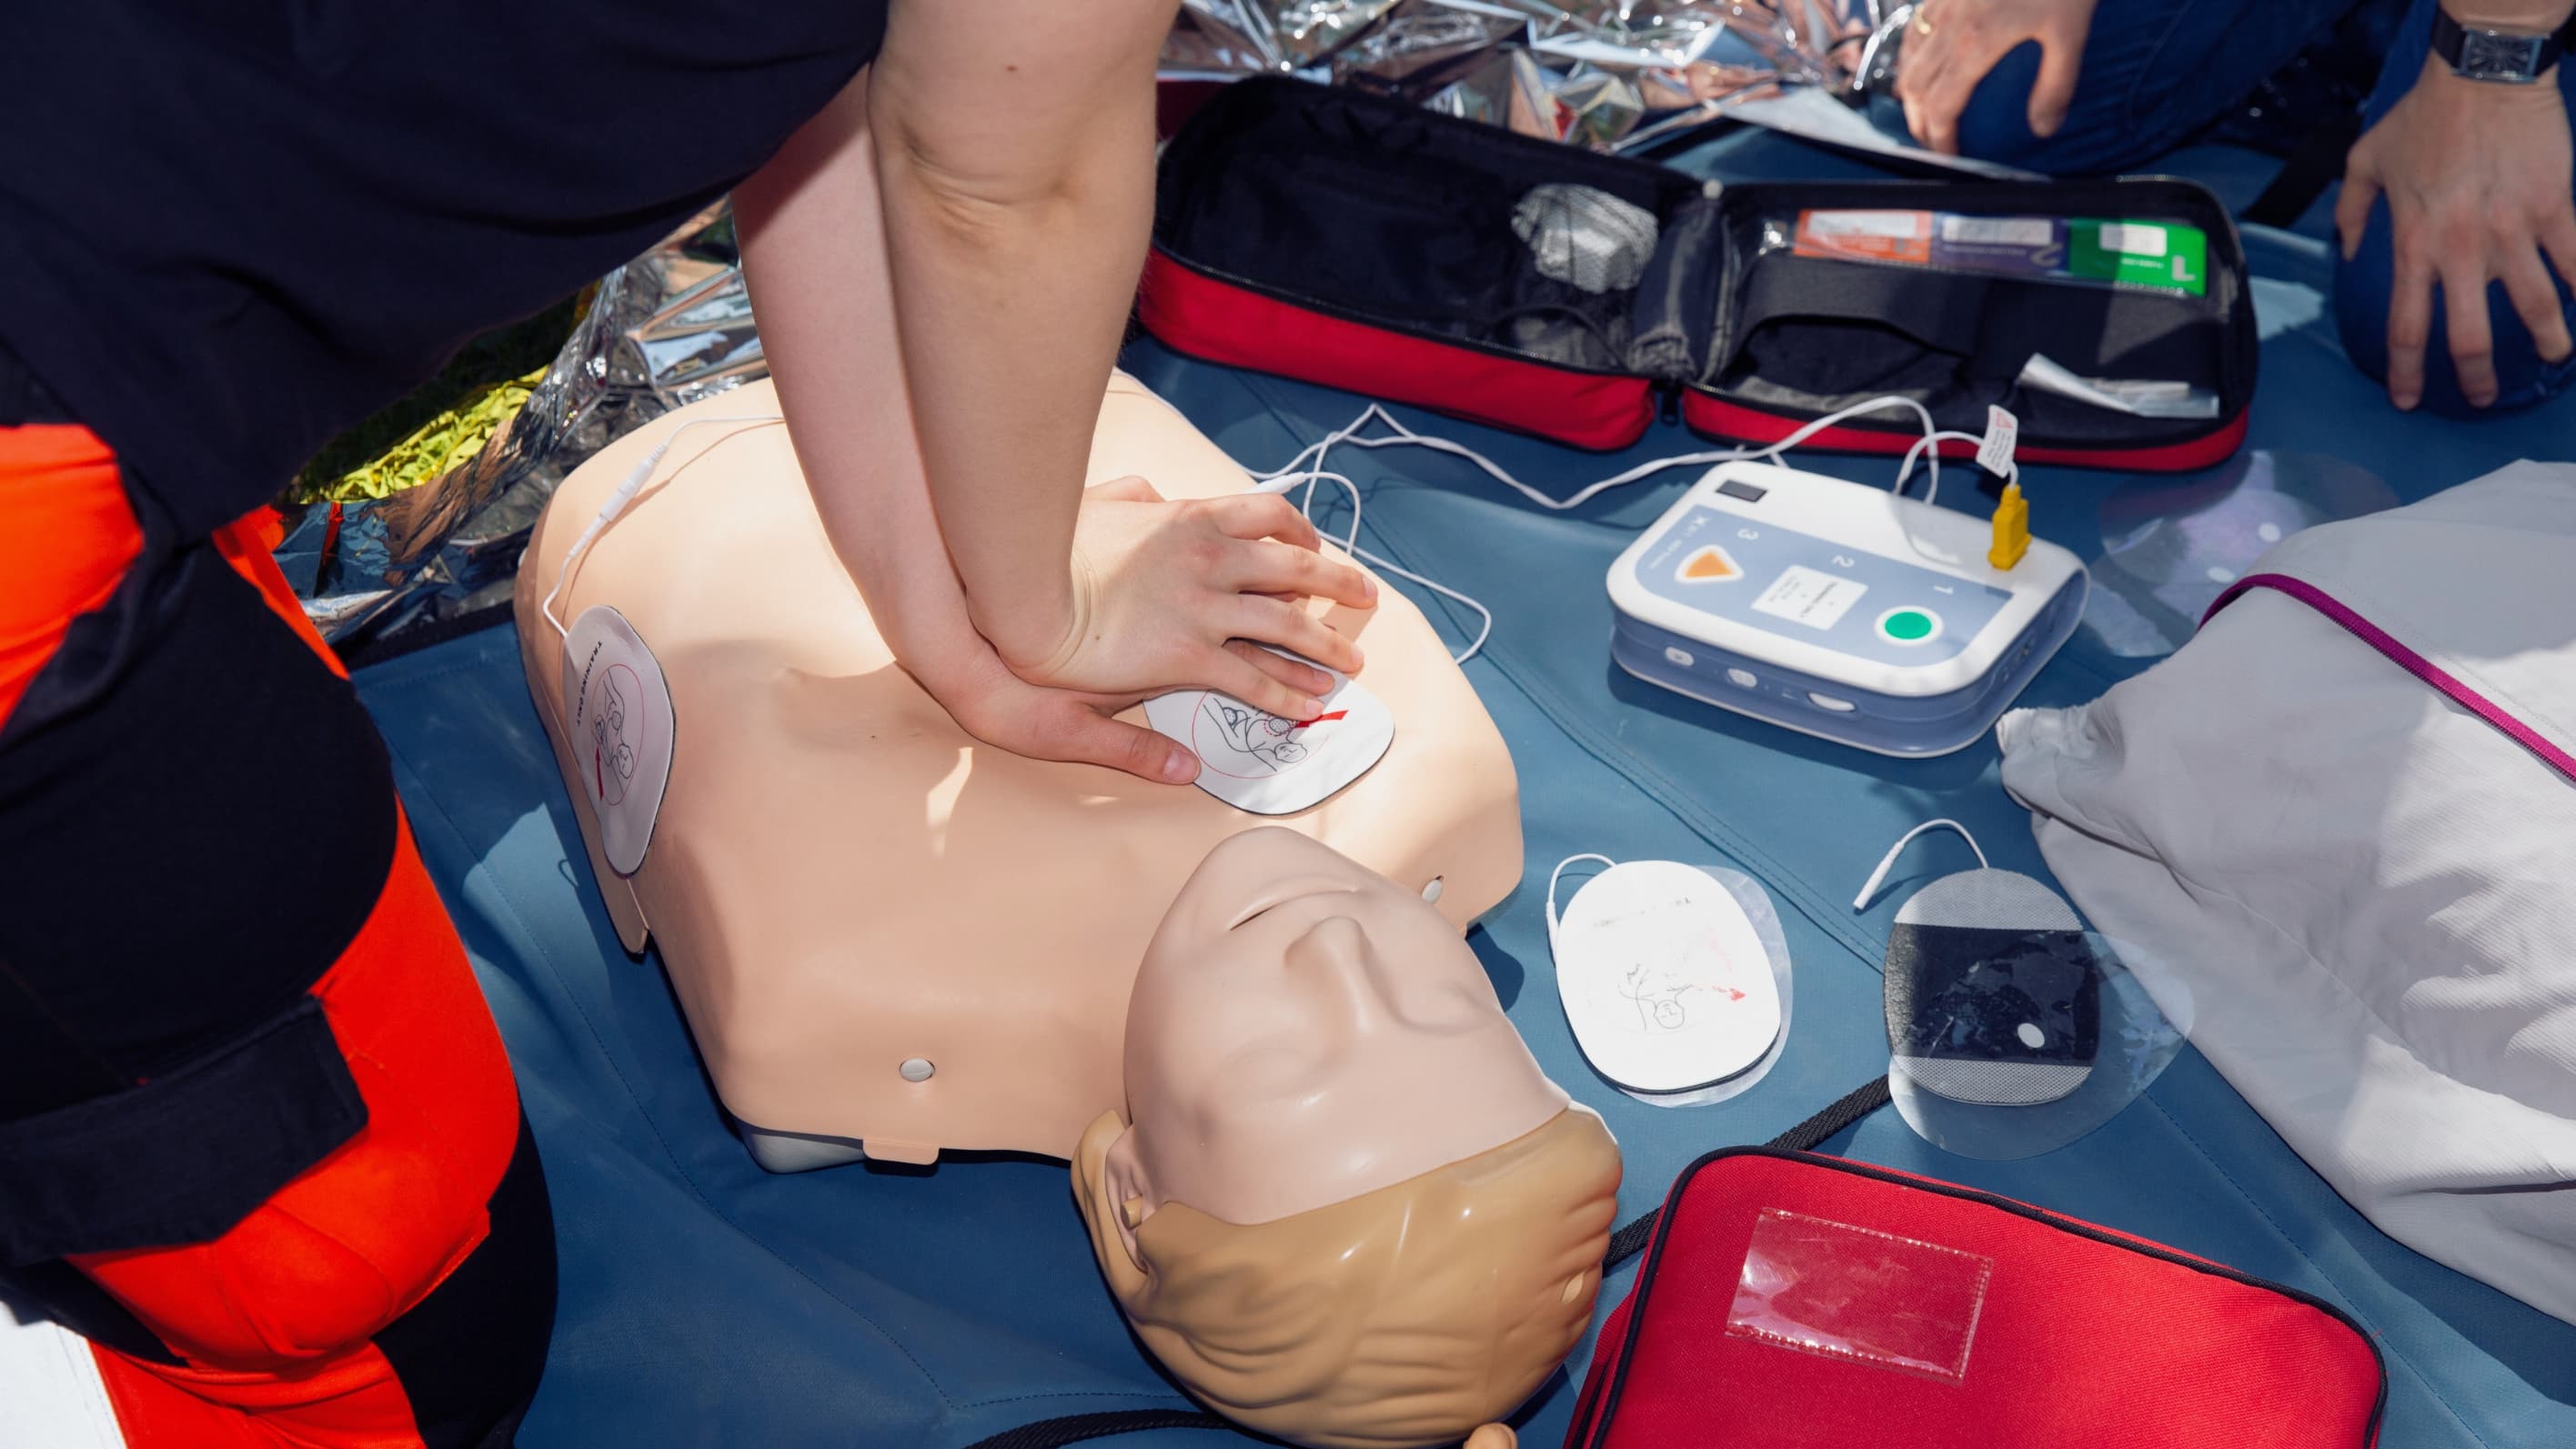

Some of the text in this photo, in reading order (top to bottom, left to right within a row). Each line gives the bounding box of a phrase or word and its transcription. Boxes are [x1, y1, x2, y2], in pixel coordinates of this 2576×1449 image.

[2030, 242, 2064, 267] 2
[2171, 255, 2197, 282] 1
[1736, 528, 1760, 541] 3
[1831, 554, 1856, 569] 2
[1933, 585, 1954, 595] 1
[580, 640, 602, 695] TRAINING
